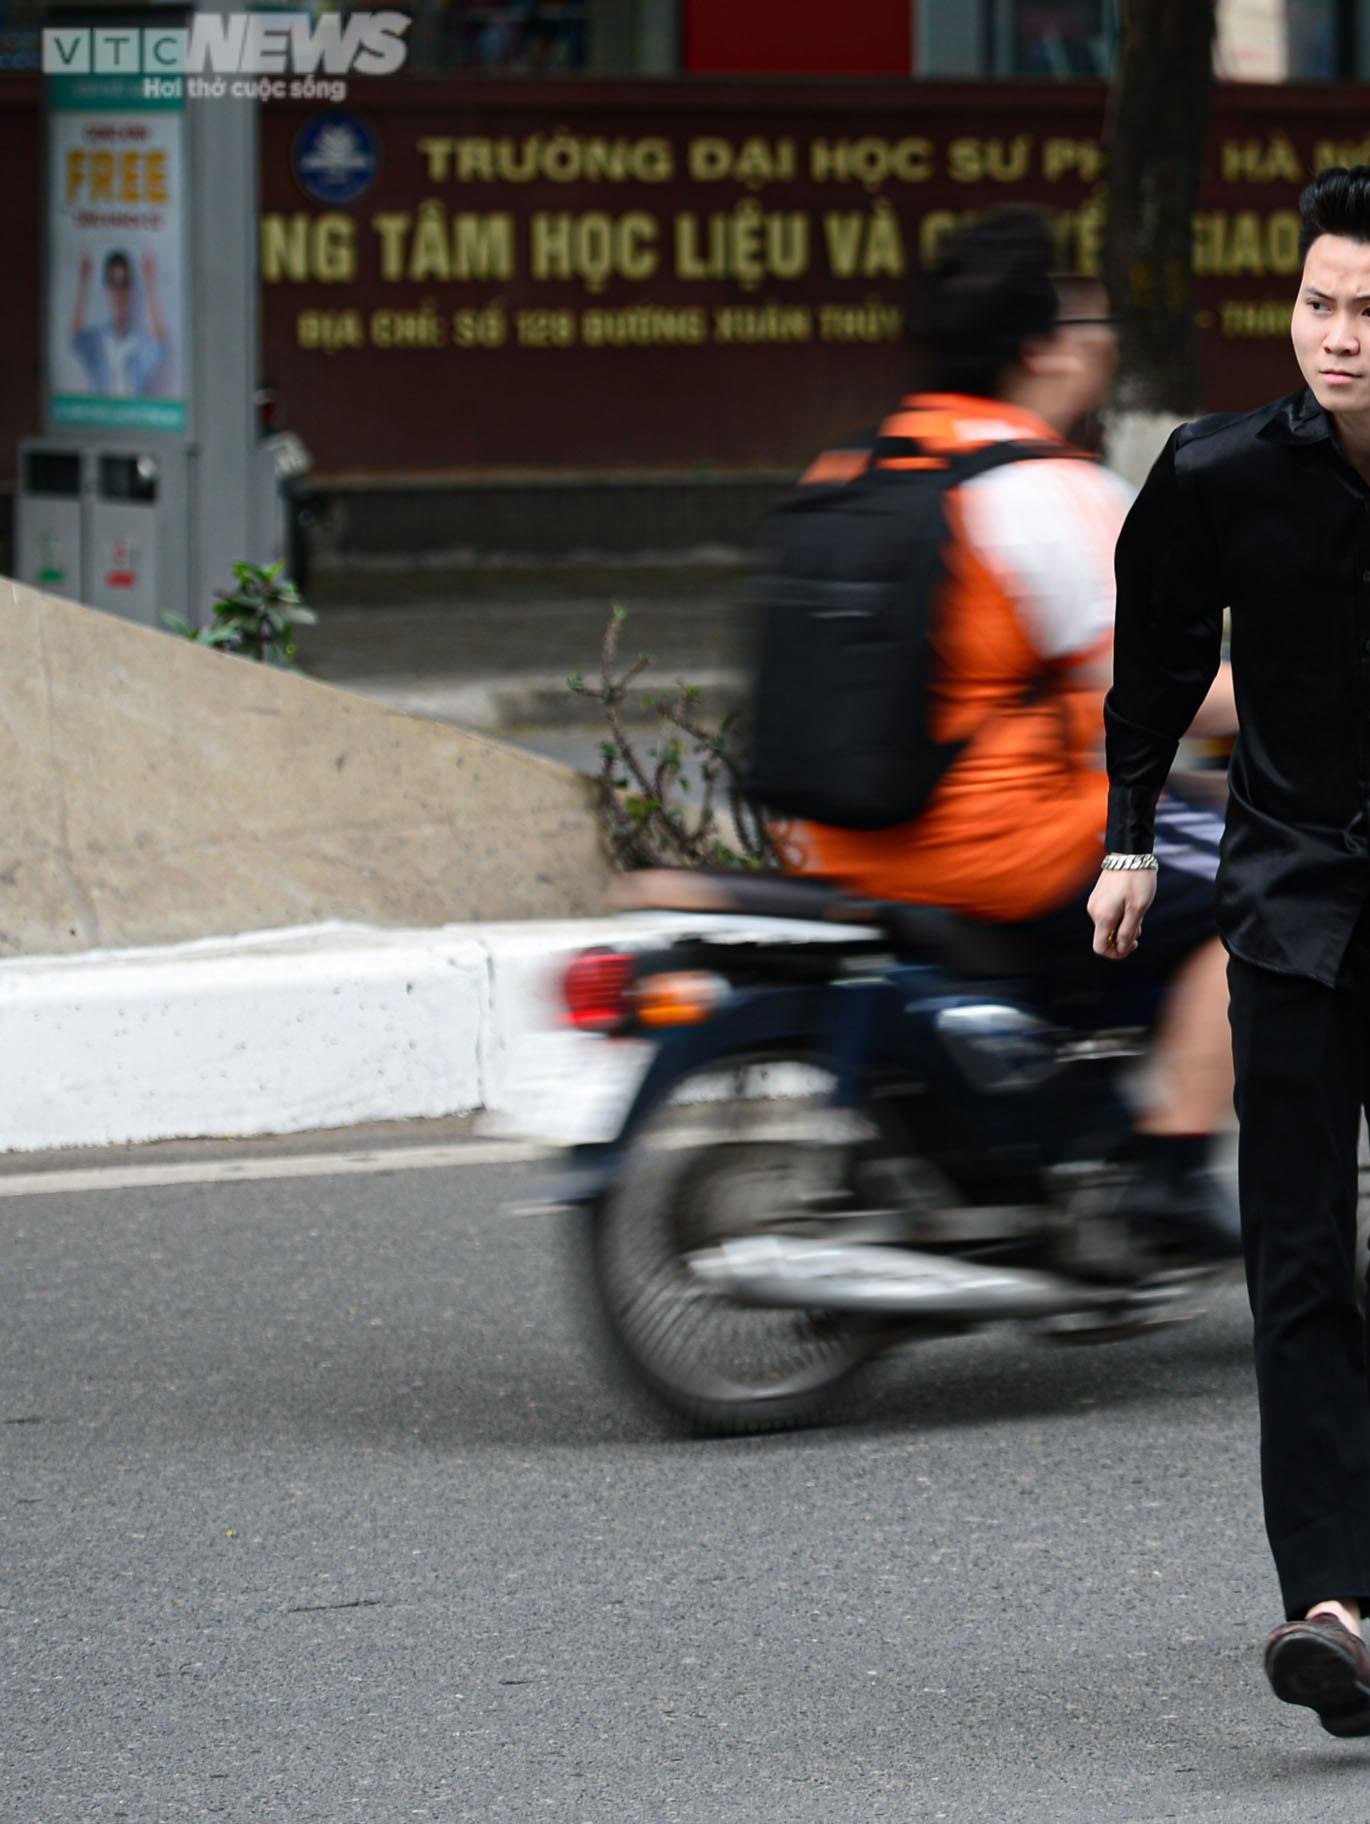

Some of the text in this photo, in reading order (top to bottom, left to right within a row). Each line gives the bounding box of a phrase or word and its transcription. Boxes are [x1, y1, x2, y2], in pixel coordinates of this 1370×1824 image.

[66, 148, 169, 204] FREE
[810, 136, 934, 193] HỌC
[948, 131, 1034, 184] SƯ
[1043, 136, 1104, 184] PH
[1220, 129, 1301, 185] HÀ
[371, 199, 516, 283] TÂM
[531, 210, 659, 293] HỌC
[675, 199, 809, 292] LIỆU
[825, 198, 902, 277] VÀ
